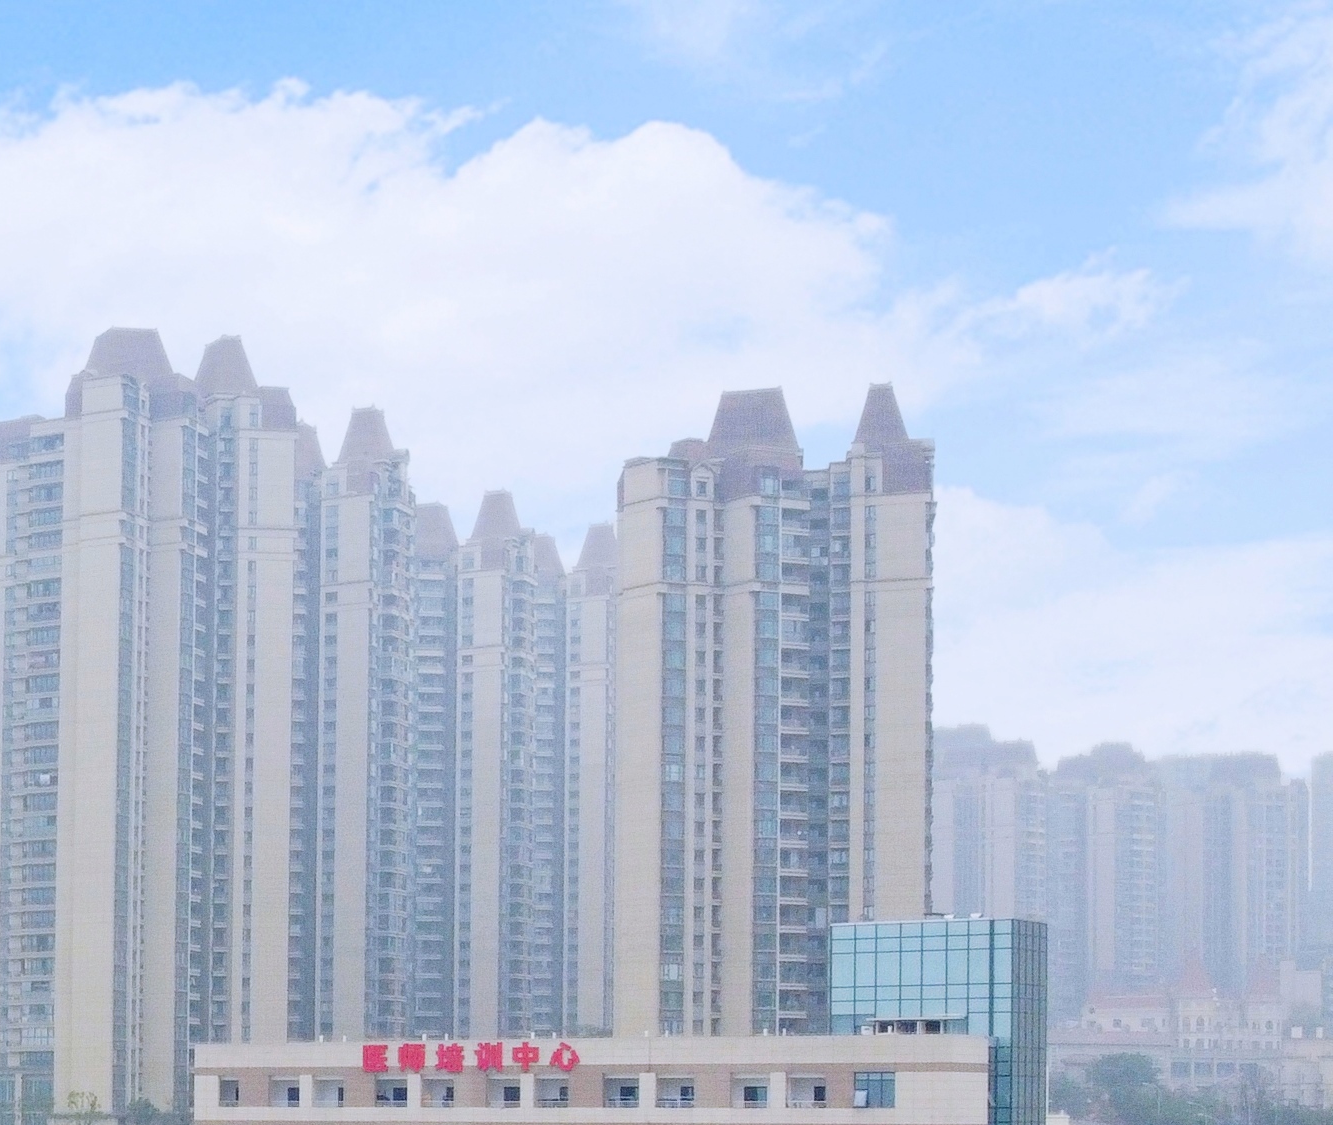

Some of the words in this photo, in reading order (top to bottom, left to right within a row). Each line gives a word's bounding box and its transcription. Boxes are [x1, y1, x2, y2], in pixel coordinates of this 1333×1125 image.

[362, 1042, 580, 1073] 医师培训中心
